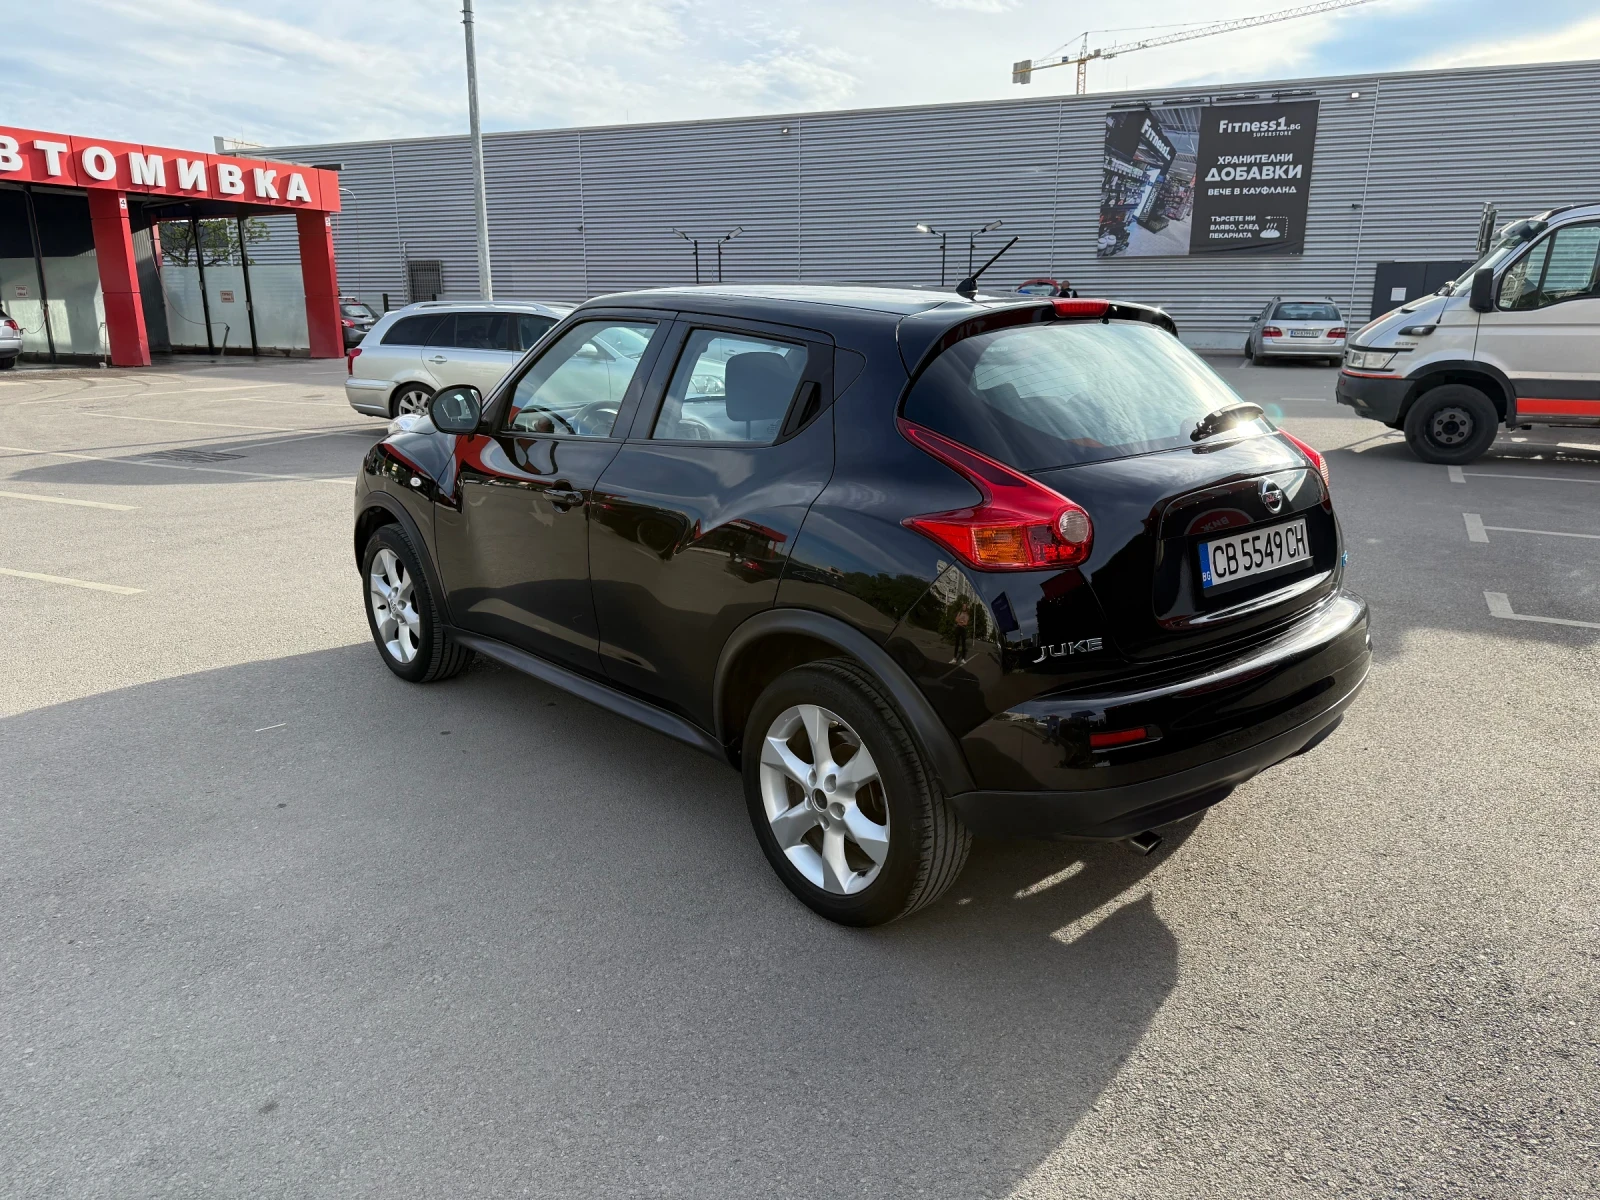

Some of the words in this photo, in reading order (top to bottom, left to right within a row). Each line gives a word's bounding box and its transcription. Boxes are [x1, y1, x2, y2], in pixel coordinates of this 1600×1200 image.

[1217, 153, 1293, 165] ХРАНИТЕЛНИ
[1204, 164, 1303, 182] ДОБАВКИ
[1207, 187, 1232, 196] ВЕЧЕ
[1233, 187, 1240, 195] В
[1242, 185, 1297, 195] КАУФЛАНД
[1238, 223, 1259, 231] СЛЕД
[1212, 542, 1239, 578] CB
[1240, 531, 1283, 571] 5549
[1285, 523, 1307, 558] CH
[1202, 571, 1211, 582] BG
[1032, 637, 1103, 664] JUKE
